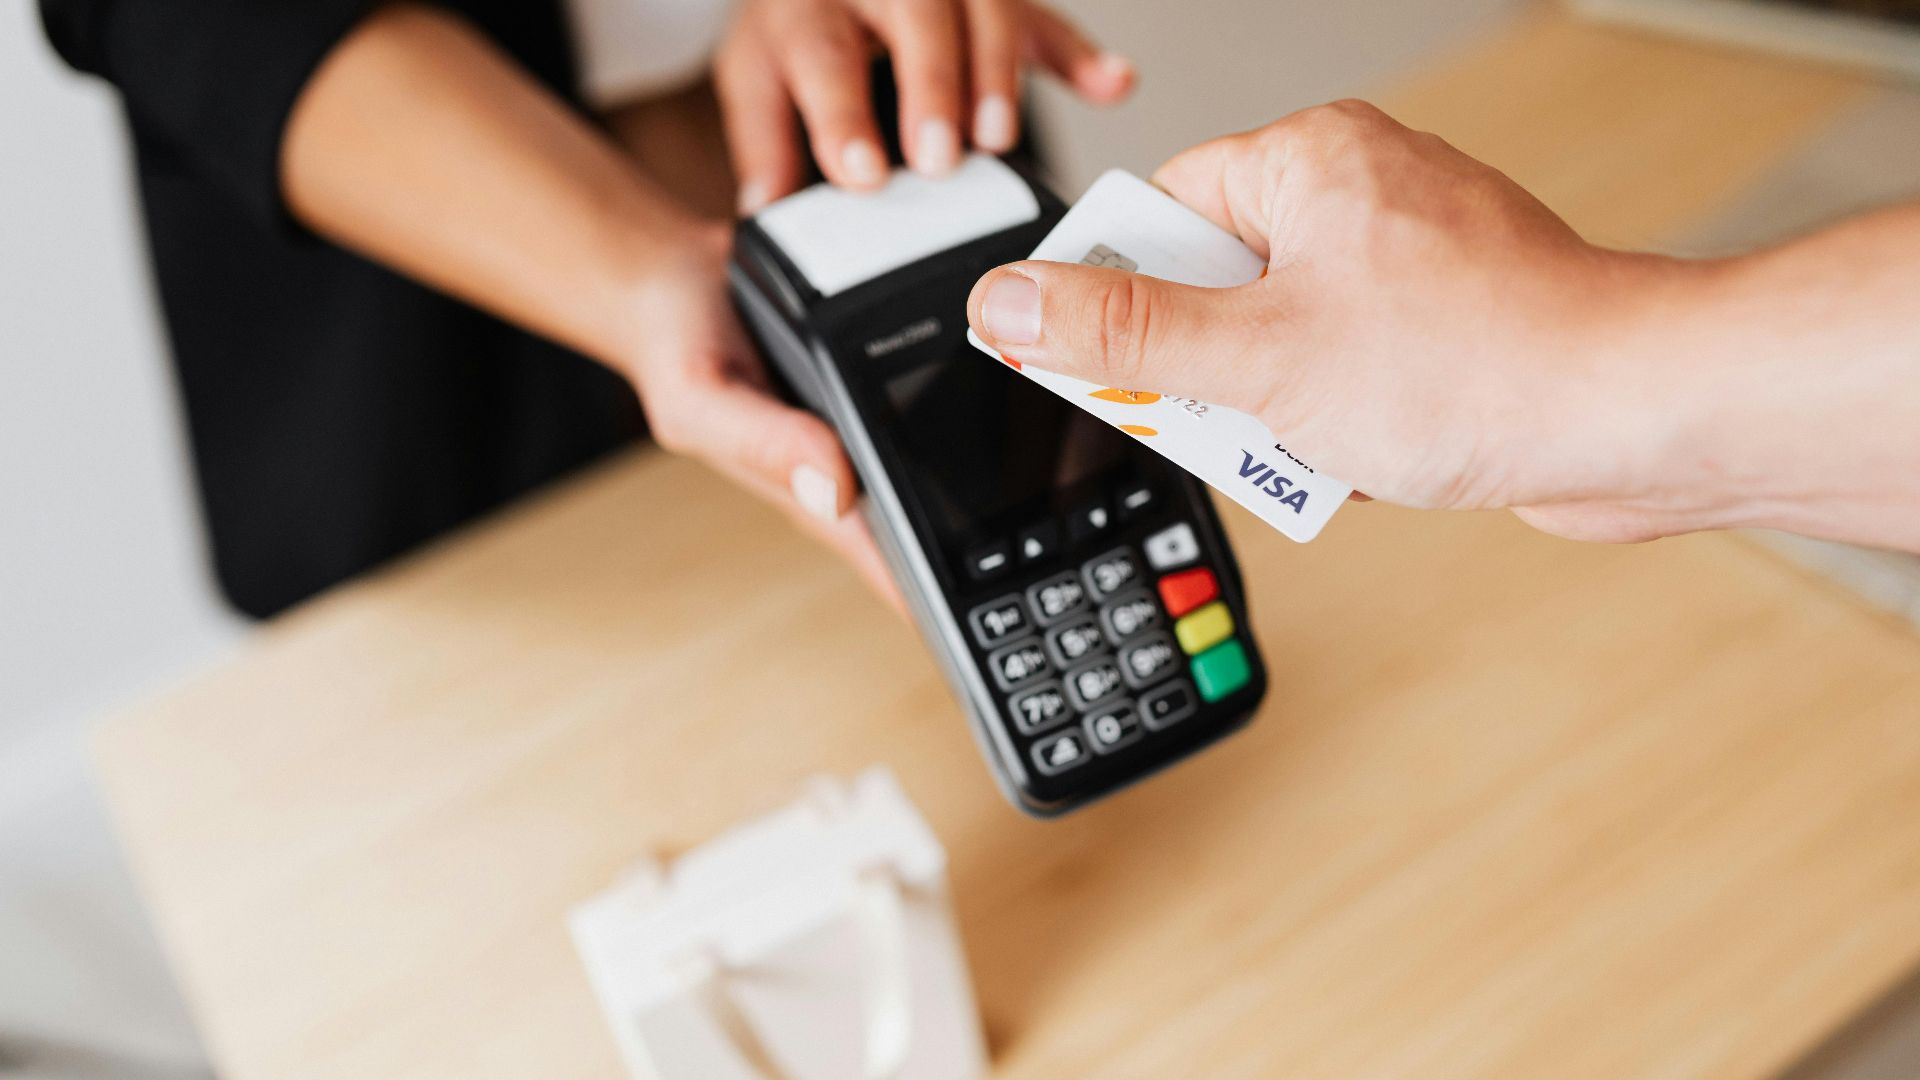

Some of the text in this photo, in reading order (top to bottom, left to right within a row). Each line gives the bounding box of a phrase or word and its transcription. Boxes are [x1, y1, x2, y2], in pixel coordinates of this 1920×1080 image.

[1237, 449, 1310, 515] VISA
[984, 610, 1005, 635] 1
[1095, 563, 1121, 592] 3
[1005, 653, 1027, 679] 4
[1021, 696, 1042, 724] 7
[1096, 715, 1121, 744] 0
